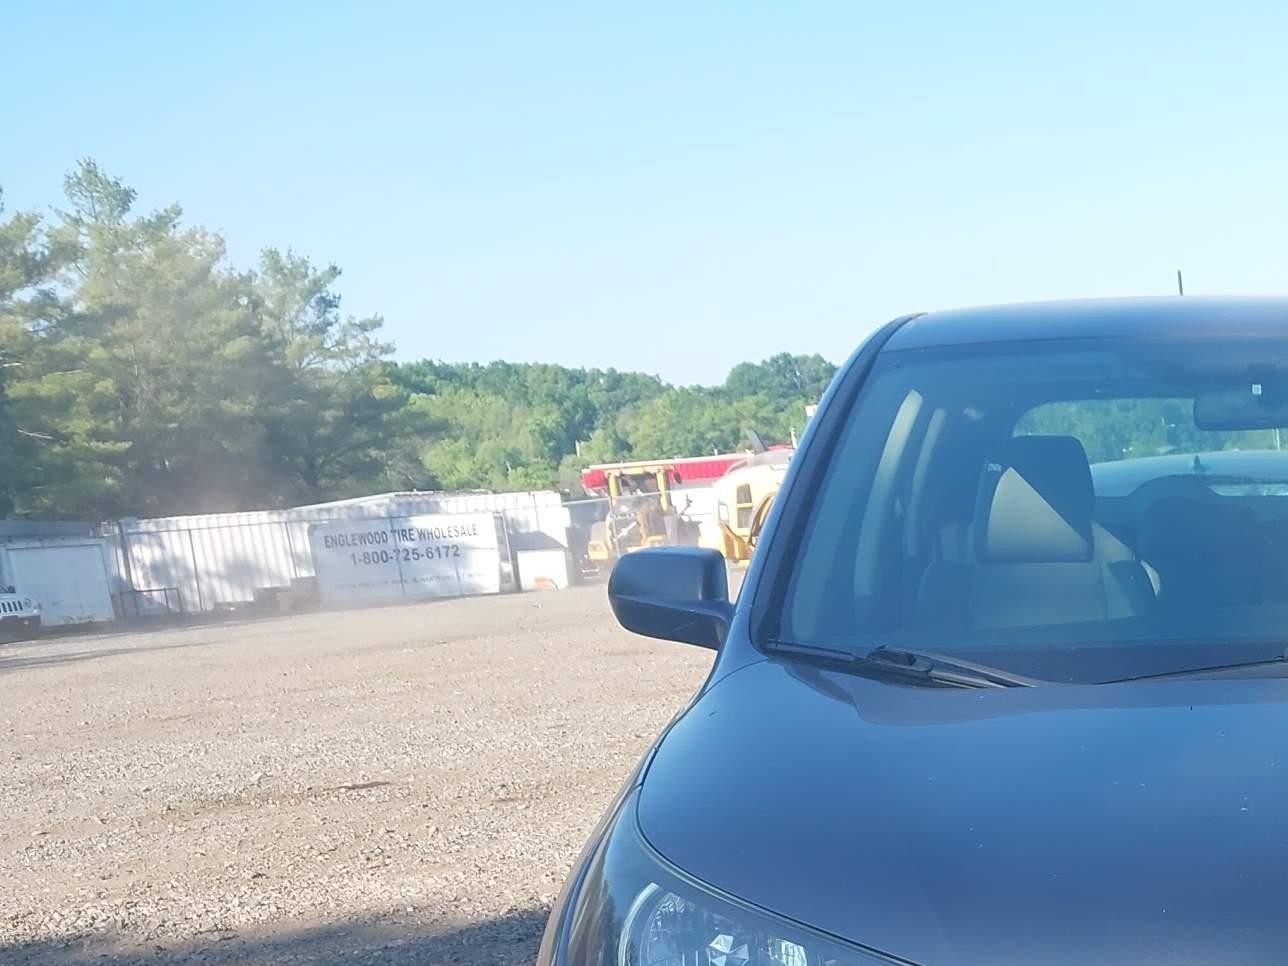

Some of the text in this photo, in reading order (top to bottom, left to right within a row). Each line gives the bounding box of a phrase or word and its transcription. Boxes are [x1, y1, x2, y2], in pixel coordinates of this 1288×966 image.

[323, 523, 479, 549] ENGLEWOOD TIRE WHOLESALE
[350, 543, 461, 566] 1-800-725-6172
